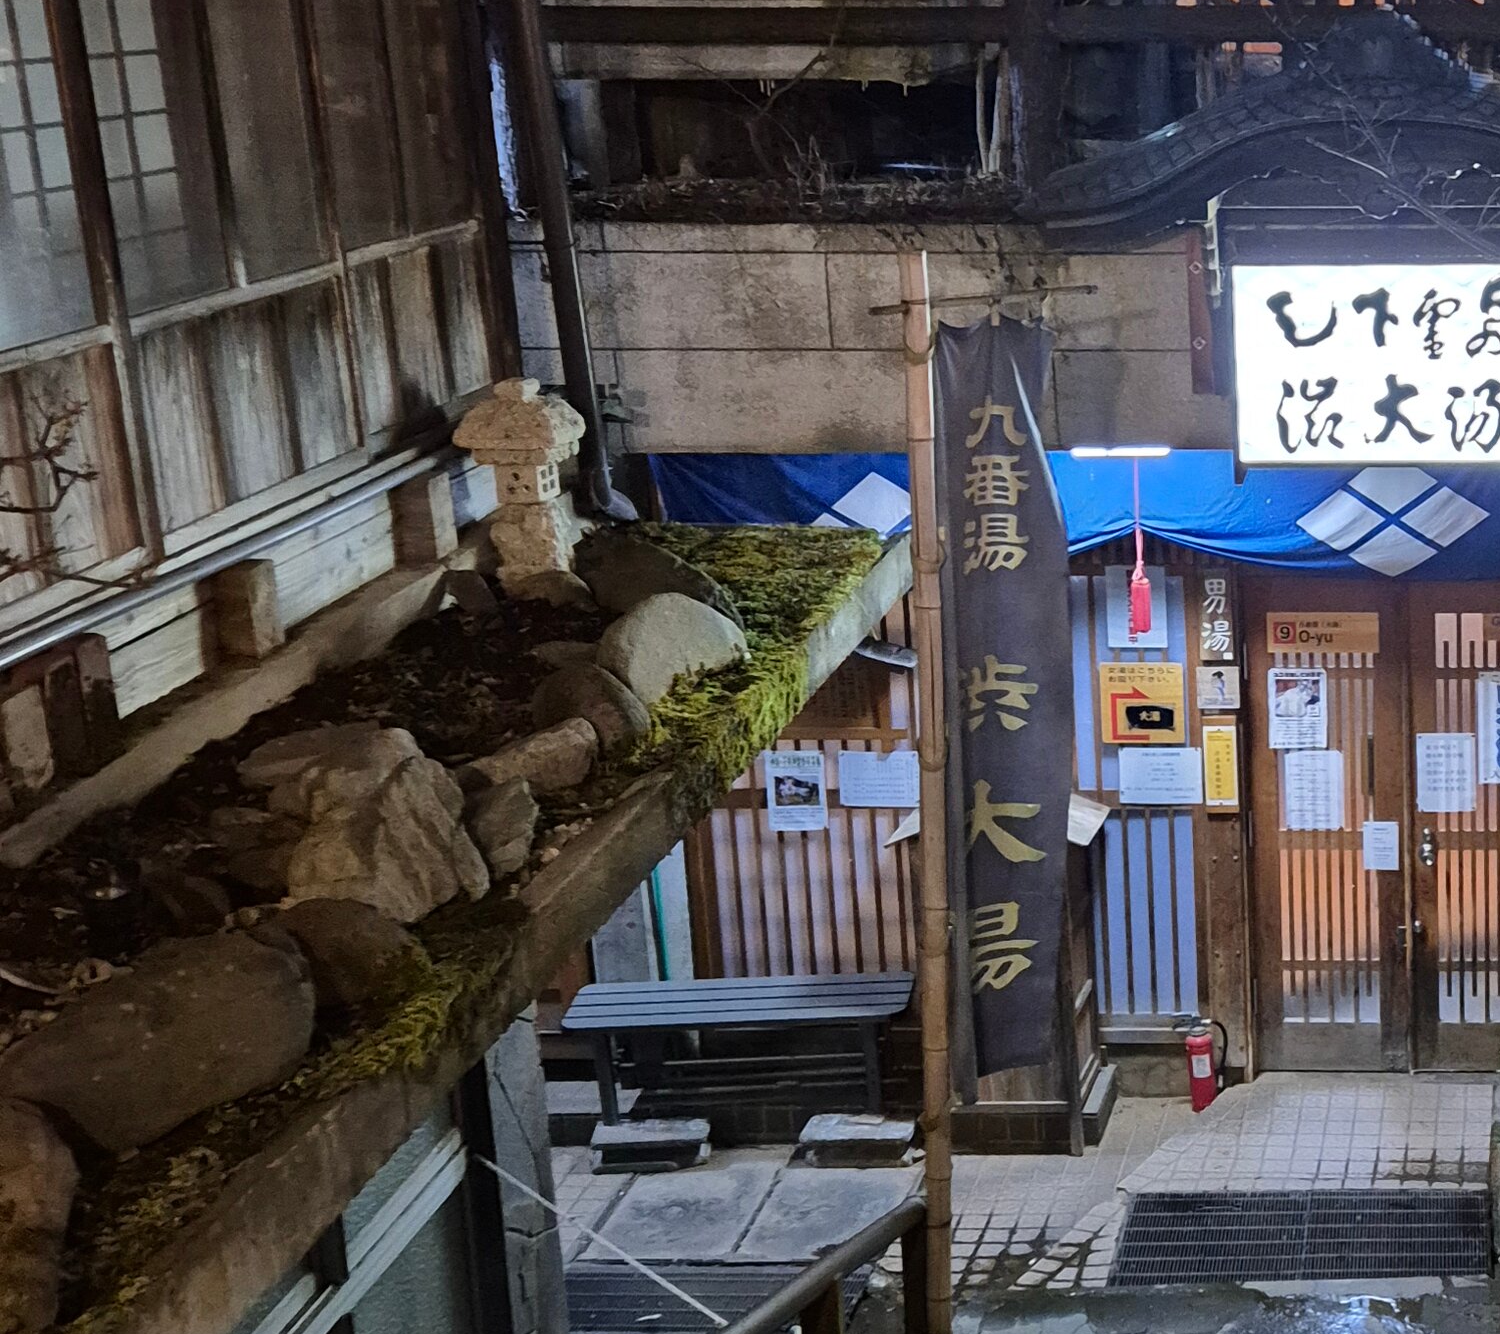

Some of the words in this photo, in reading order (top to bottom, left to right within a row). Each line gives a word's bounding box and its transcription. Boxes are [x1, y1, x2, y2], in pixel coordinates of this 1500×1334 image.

[963, 394, 1032, 575] 九番湯
[1201, 577, 1232, 653] 男湯
[1279, 626, 1291, 640] 9
[1299, 630, 1334, 646] O-yu
[1107, 666, 1177, 674] 女湯はこちらに
[1108, 675, 1171, 683] お回り下さい。
